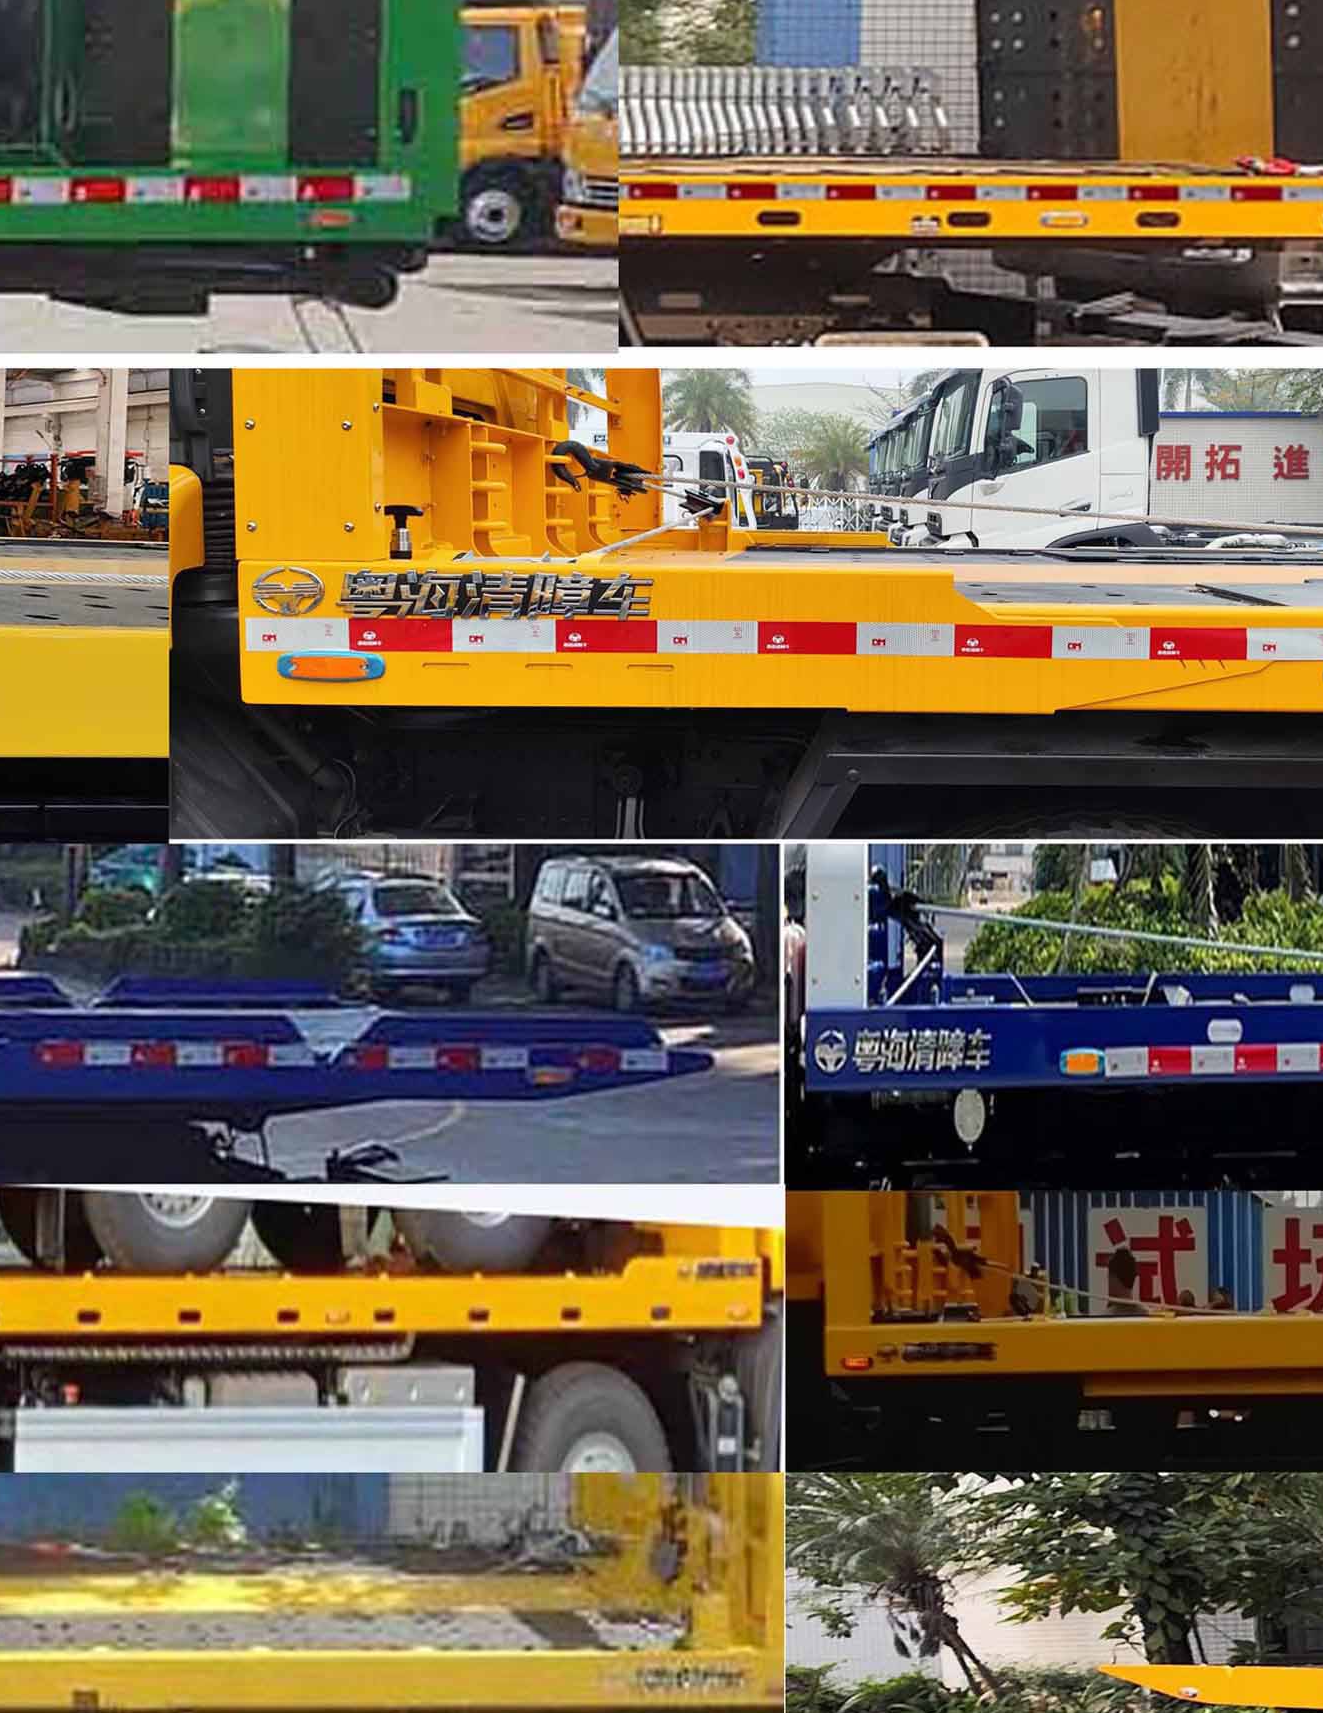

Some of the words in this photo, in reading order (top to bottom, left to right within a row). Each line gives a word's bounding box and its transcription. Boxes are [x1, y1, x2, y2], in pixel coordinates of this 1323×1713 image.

[336, 570, 654, 620] 粤海清障车
